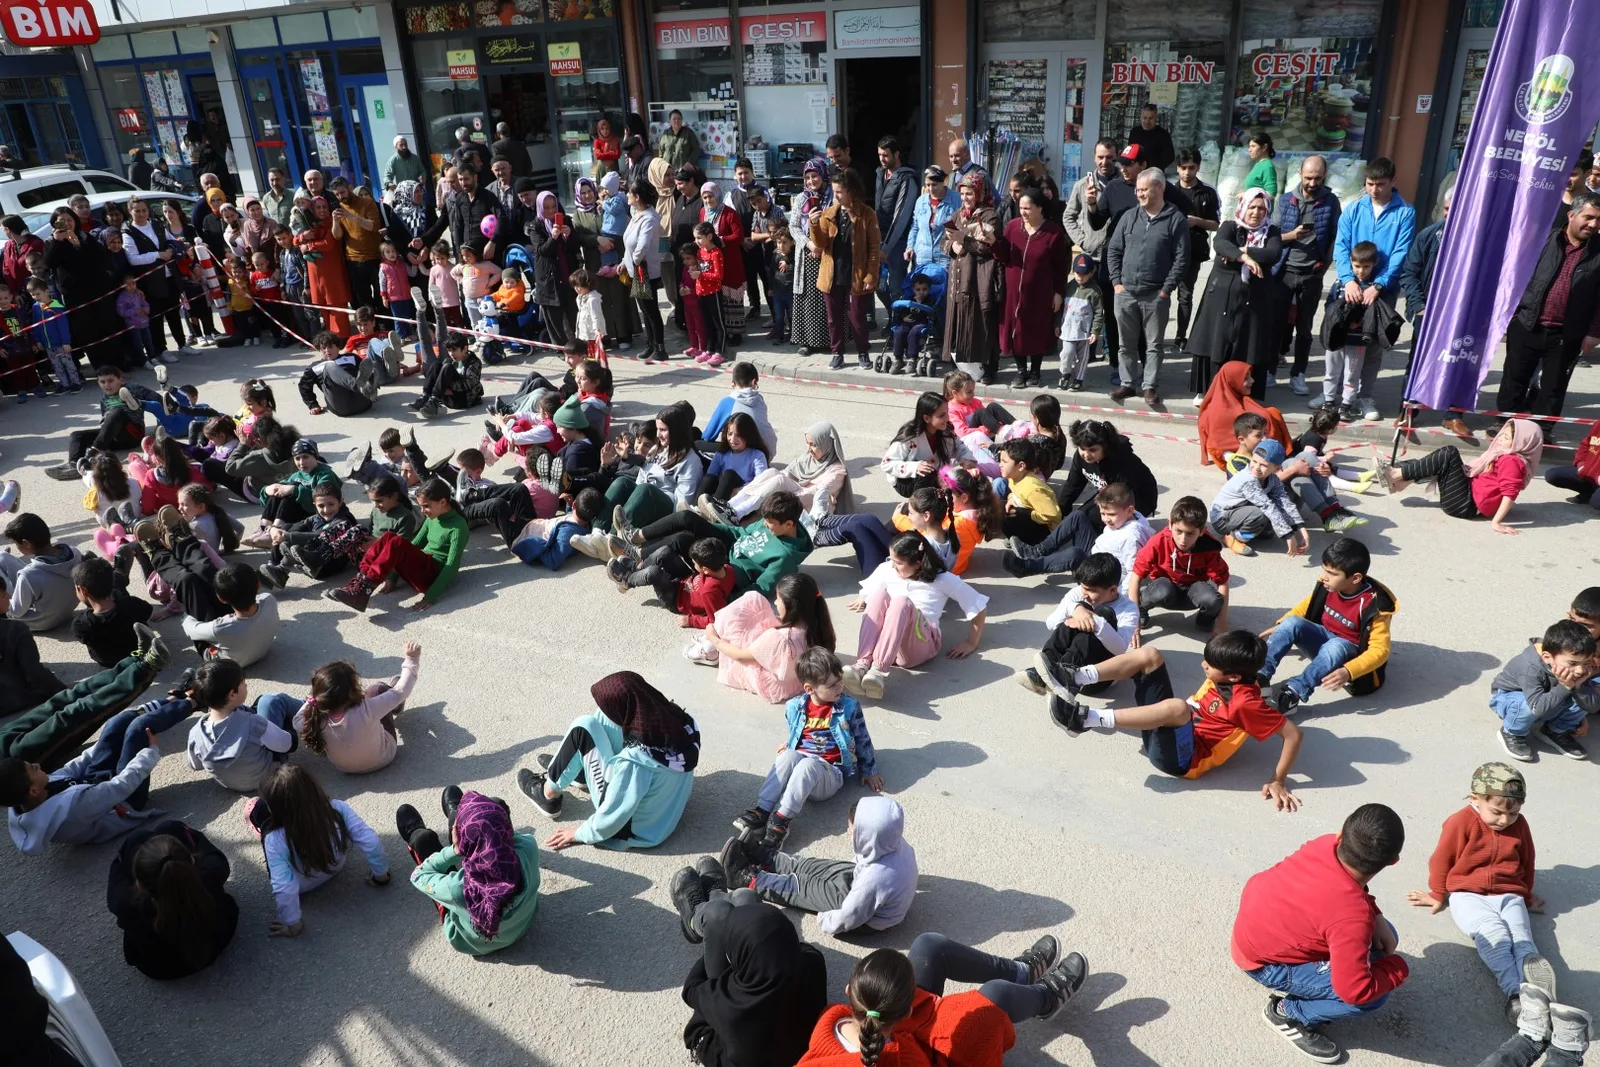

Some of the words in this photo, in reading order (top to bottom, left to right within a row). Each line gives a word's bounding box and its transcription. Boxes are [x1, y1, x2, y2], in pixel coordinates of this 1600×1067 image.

[661, 25, 691, 45] BİN
[696, 22, 728, 43] BİN
[749, 17, 815, 43] ÇEŞİT
[450, 65, 476, 76] MAHSUL
[551, 59, 580, 70] MAHSUL
[1111, 56, 1159, 84] BİN
[1164, 55, 1214, 84] BİN
[1253, 47, 1340, 83] ÇEŞİT
